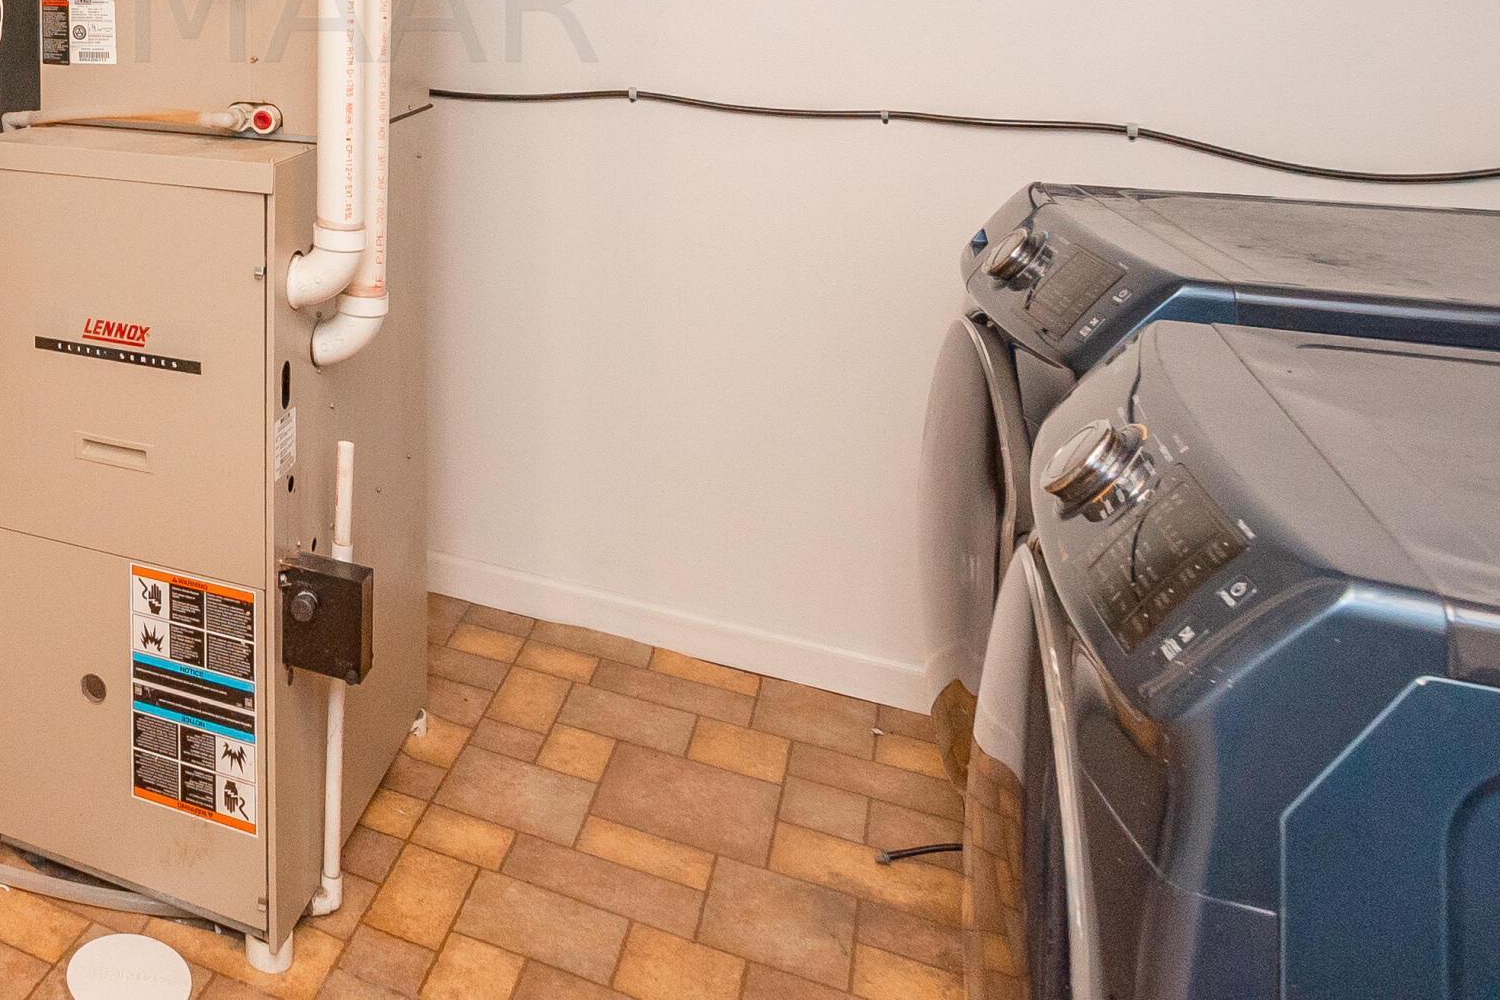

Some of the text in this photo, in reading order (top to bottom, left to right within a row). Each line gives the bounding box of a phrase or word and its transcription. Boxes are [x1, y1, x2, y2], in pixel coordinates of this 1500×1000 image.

[84, 318, 151, 342] LENNOX
[58, 343, 178, 368] ELITE SERIES
[178, 578, 208, 591] WARNING
[179, 666, 204, 677] NOTICE
[181, 715, 206, 728] NOTICE
